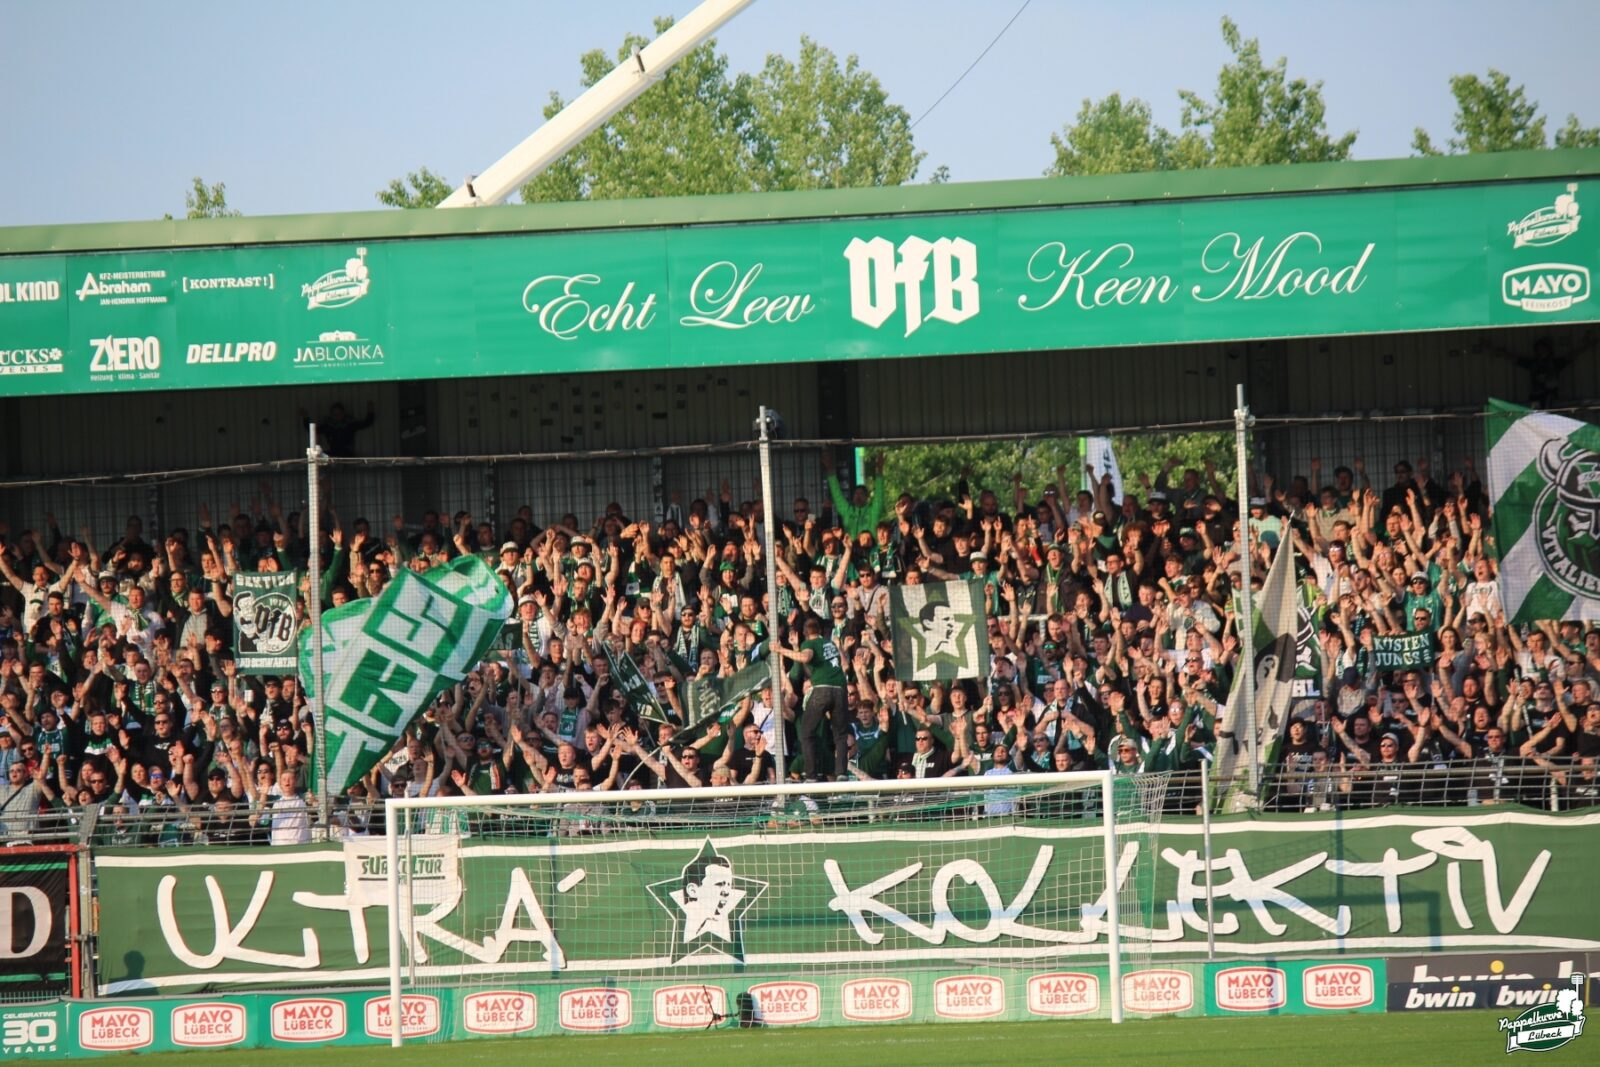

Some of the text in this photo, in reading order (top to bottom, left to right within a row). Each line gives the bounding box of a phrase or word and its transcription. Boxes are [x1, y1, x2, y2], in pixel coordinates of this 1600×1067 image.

[75, 272, 152, 302] Abraham
[521, 231, 1376, 340] Echt Leev VfB Keen Mood
[1511, 273, 1582, 296] MAYO
[186, 341, 277, 364] DELLPRO
[293, 344, 384, 363] JABLONKA
[1373, 632, 1430, 651] KÜSTEN
[1375, 651, 1421, 666] JUNGS
[1133, 976, 1181, 991] MAYO
[1227, 973, 1274, 988] MAYO
[1314, 971, 1362, 986] MAYO
[853, 985, 900, 999] MAYO
[946, 982, 993, 996] MAYO
[1039, 979, 1088, 994] MAYO
[1227, 987, 1273, 1000] LÜBECK
[1314, 985, 1361, 998] LÜBECK
[571, 994, 619, 1009] MAYO
[666, 991, 714, 1006] MAYO
[760, 988, 808, 1002] MAYO
[946, 995, 992, 1008] LÜBECK
[1039, 992, 1087, 1006] LÜBECK
[1133, 989, 1180, 1003] LÜBECK
[1405, 986, 1476, 1009] bwin
[476, 997, 524, 1012] MAYO
[760, 1001, 807, 1014] LÜBECK
[853, 997, 899, 1010] LÜBECK
[3, 1011, 57, 1019] CELEBRATING
[184, 1009, 233, 1024] MAYO
[283, 1005, 333, 1020] MAYO
[476, 1010, 523, 1024] LÜBECK
[571, 1007, 618, 1020] LÜBECK
[666, 1004, 713, 1018] LÜBECK
[92, 1013, 140, 1028] MAYO
[283, 1018, 332, 1032] LÜBECK
[377, 1014, 426, 1028] LÜECK
[2, 1018, 57, 1046] 30
[92, 1027, 139, 1040] LÜBECK
[184, 1023, 232, 1036] LÜBECK
[3, 1045, 57, 1054] YEARS
